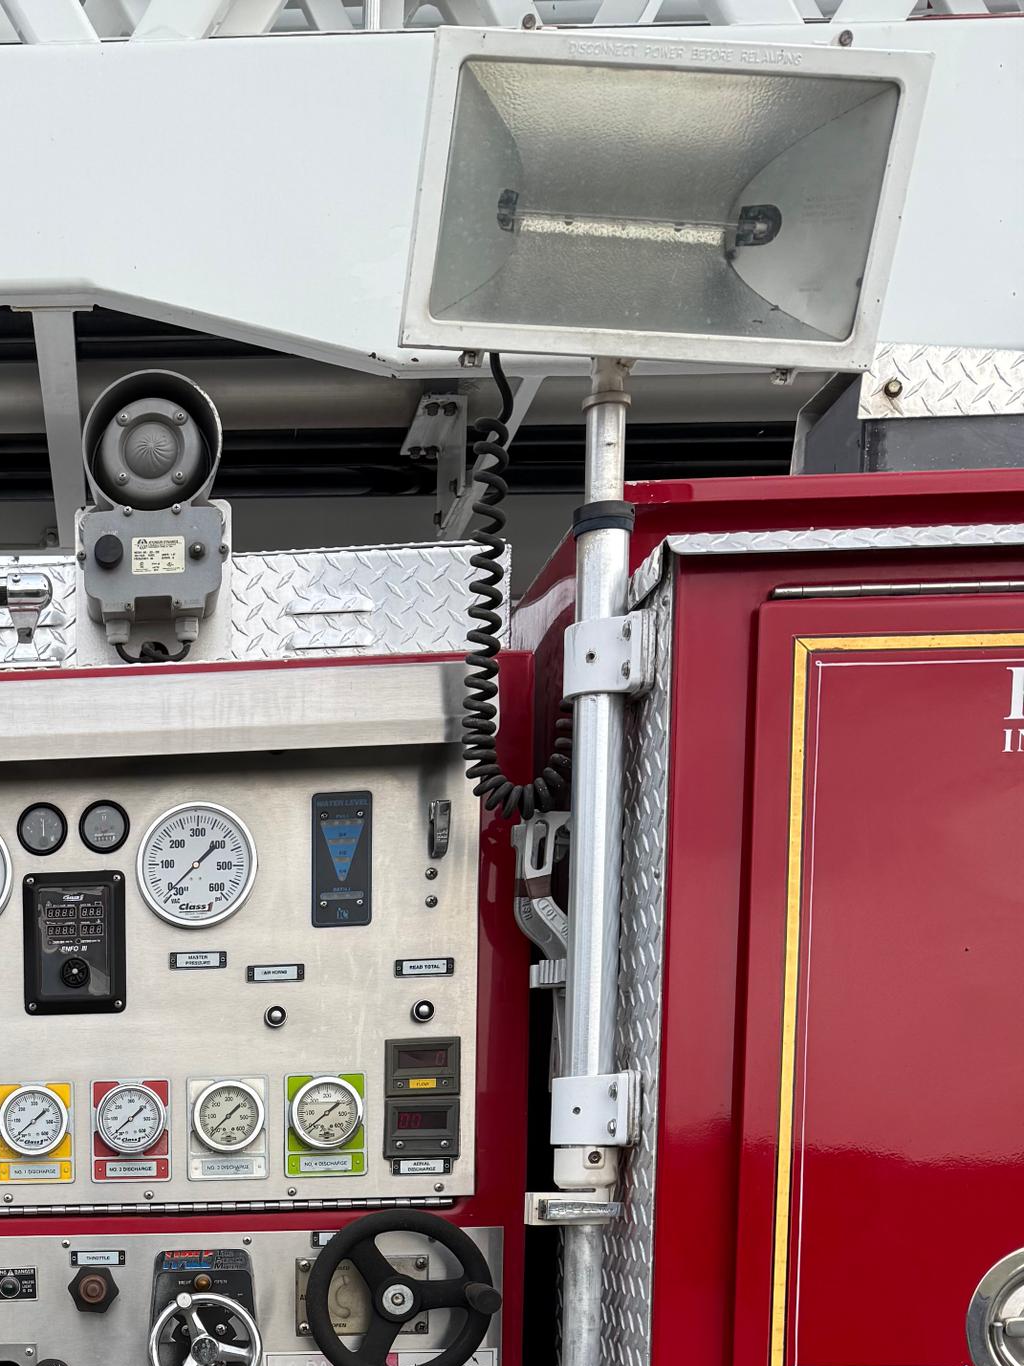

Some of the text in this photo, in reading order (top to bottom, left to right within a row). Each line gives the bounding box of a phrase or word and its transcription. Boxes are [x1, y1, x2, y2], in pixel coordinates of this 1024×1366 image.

[568, 40, 803, 66] DISCONNECT POWER BEFORE RELAMPING
[190, 828, 206, 837] 300
[169, 839, 186, 849] 200
[209, 840, 226, 850] 400
[160, 859, 175, 869] 100
[216, 861, 233, 871] 500
[208, 882, 225, 892] 600
